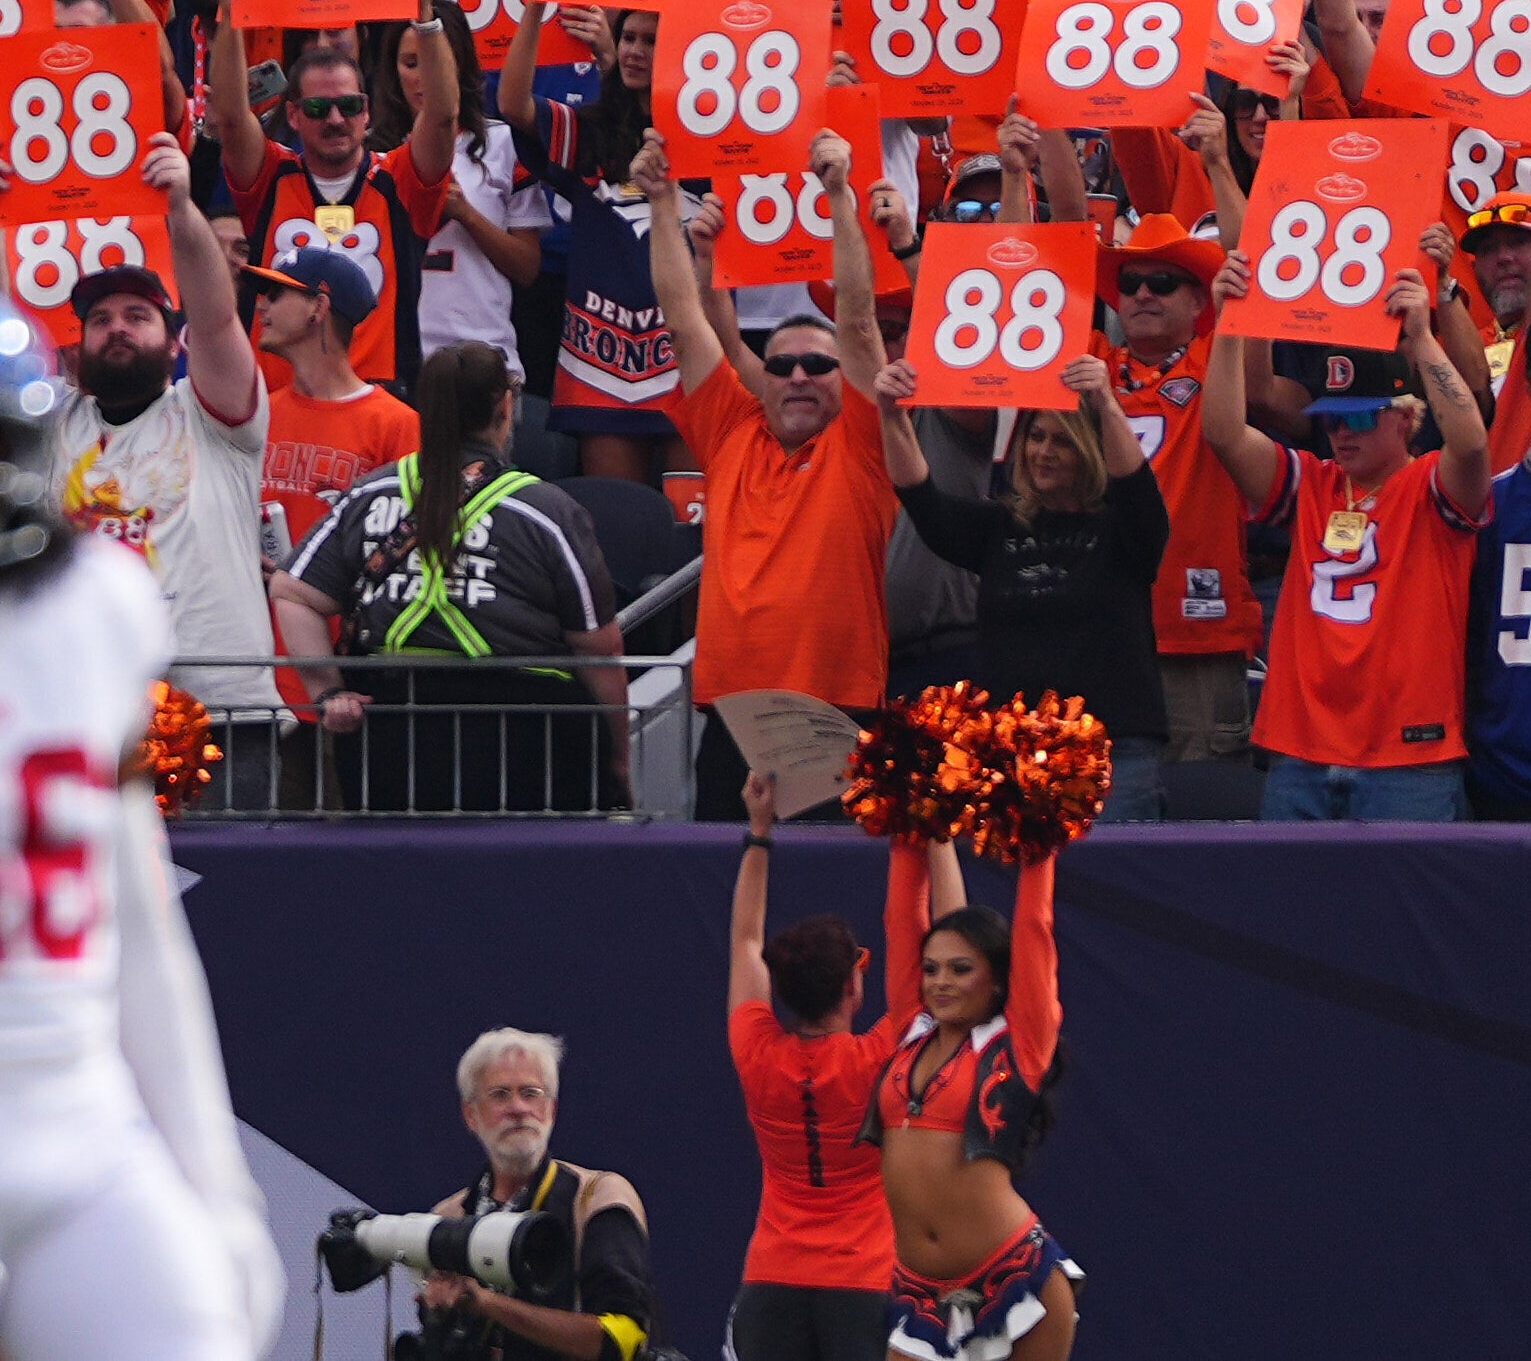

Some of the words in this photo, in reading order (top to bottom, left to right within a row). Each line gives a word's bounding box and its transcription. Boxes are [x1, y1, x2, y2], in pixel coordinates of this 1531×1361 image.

[934, 269, 1066, 371] 88
[96, 515, 150, 545] 88
[1310, 547, 1379, 624] 2
